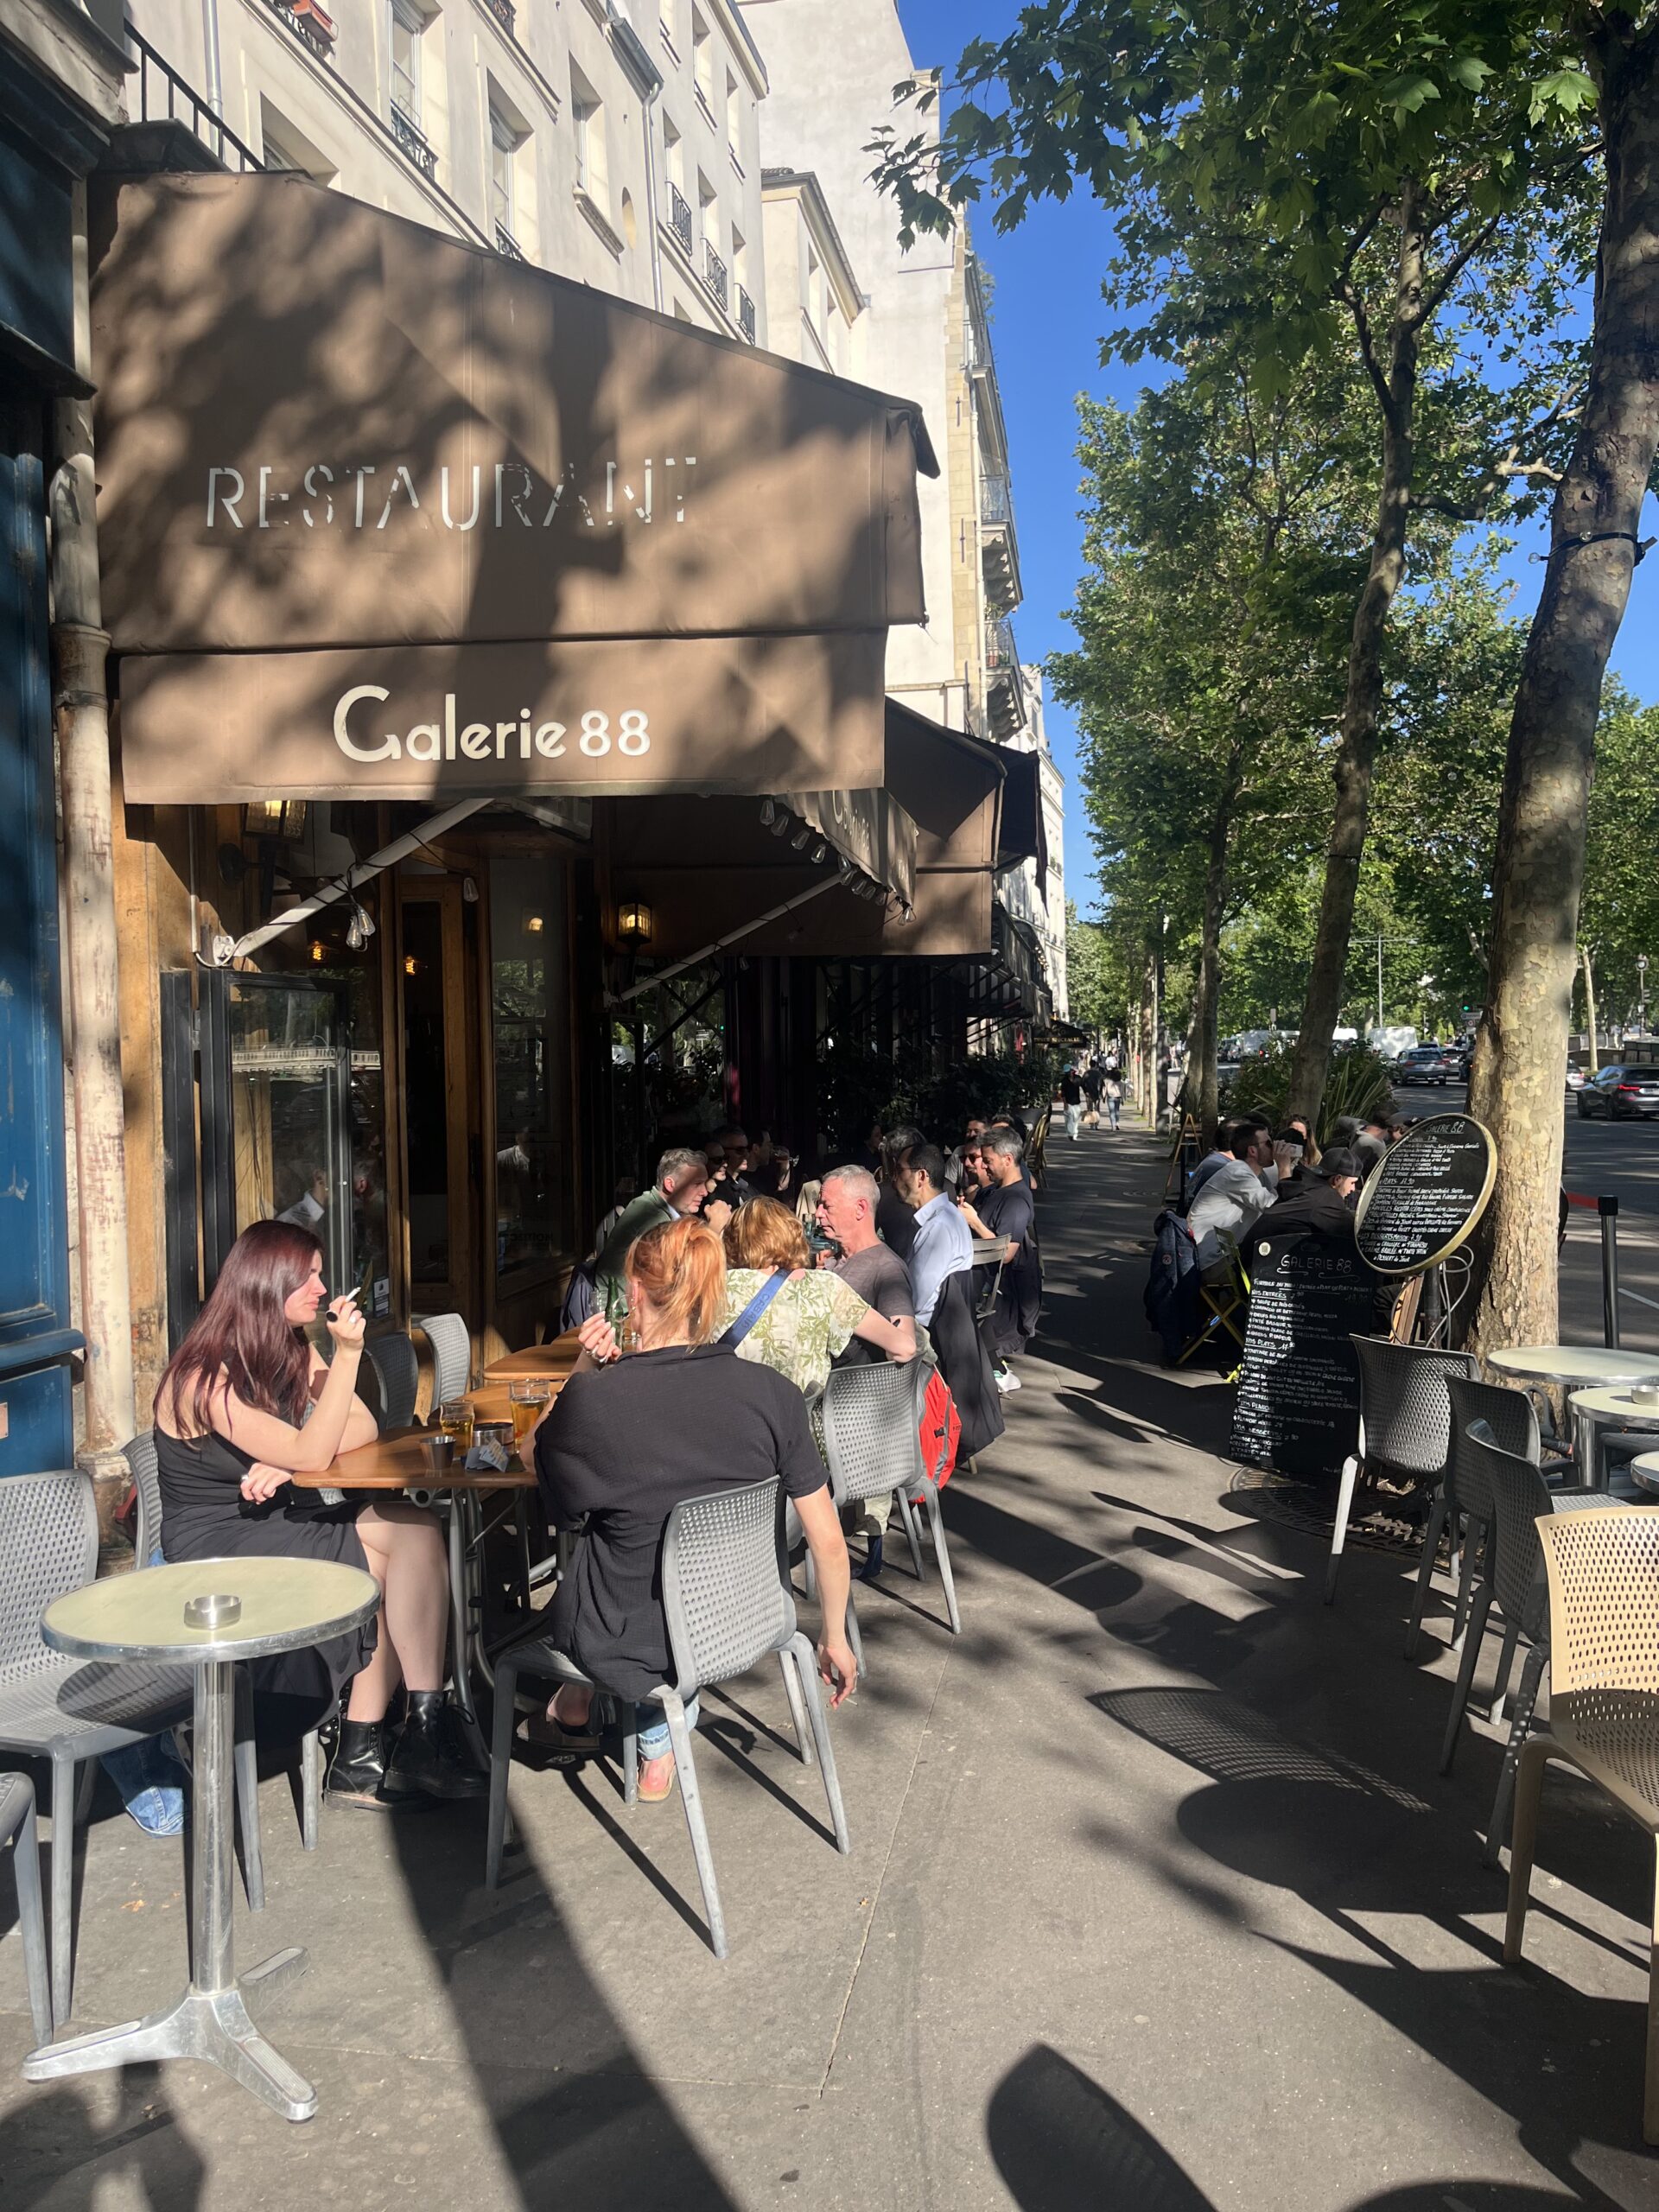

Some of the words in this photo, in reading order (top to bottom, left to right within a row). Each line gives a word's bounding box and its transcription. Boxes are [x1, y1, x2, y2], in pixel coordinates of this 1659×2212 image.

[206, 455, 697, 531] RESTAURANT
[333, 684, 567, 763] Galerie
[578, 709, 652, 758] 88
[1450, 1121, 1465, 1134] 88
[1281, 1254, 1335, 1270] GALERIE
[1336, 1258, 1352, 1274] 88
